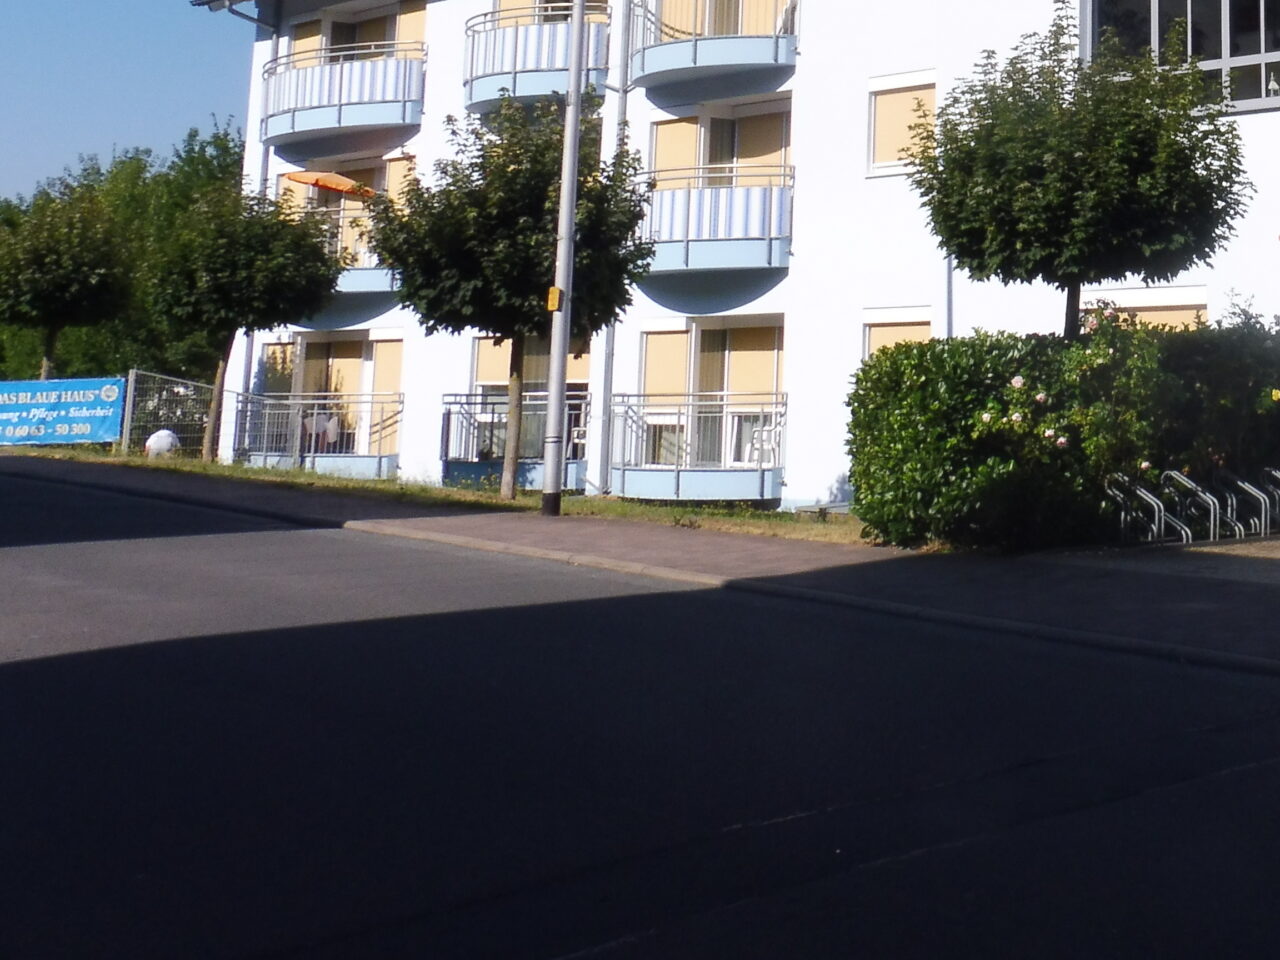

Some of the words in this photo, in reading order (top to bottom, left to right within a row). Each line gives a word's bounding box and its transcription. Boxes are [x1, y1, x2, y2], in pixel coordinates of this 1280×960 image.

[17, 391, 59, 404] BLAUE
[28, 407, 58, 422] Pflege
[68, 406, 114, 418] Sicherheit
